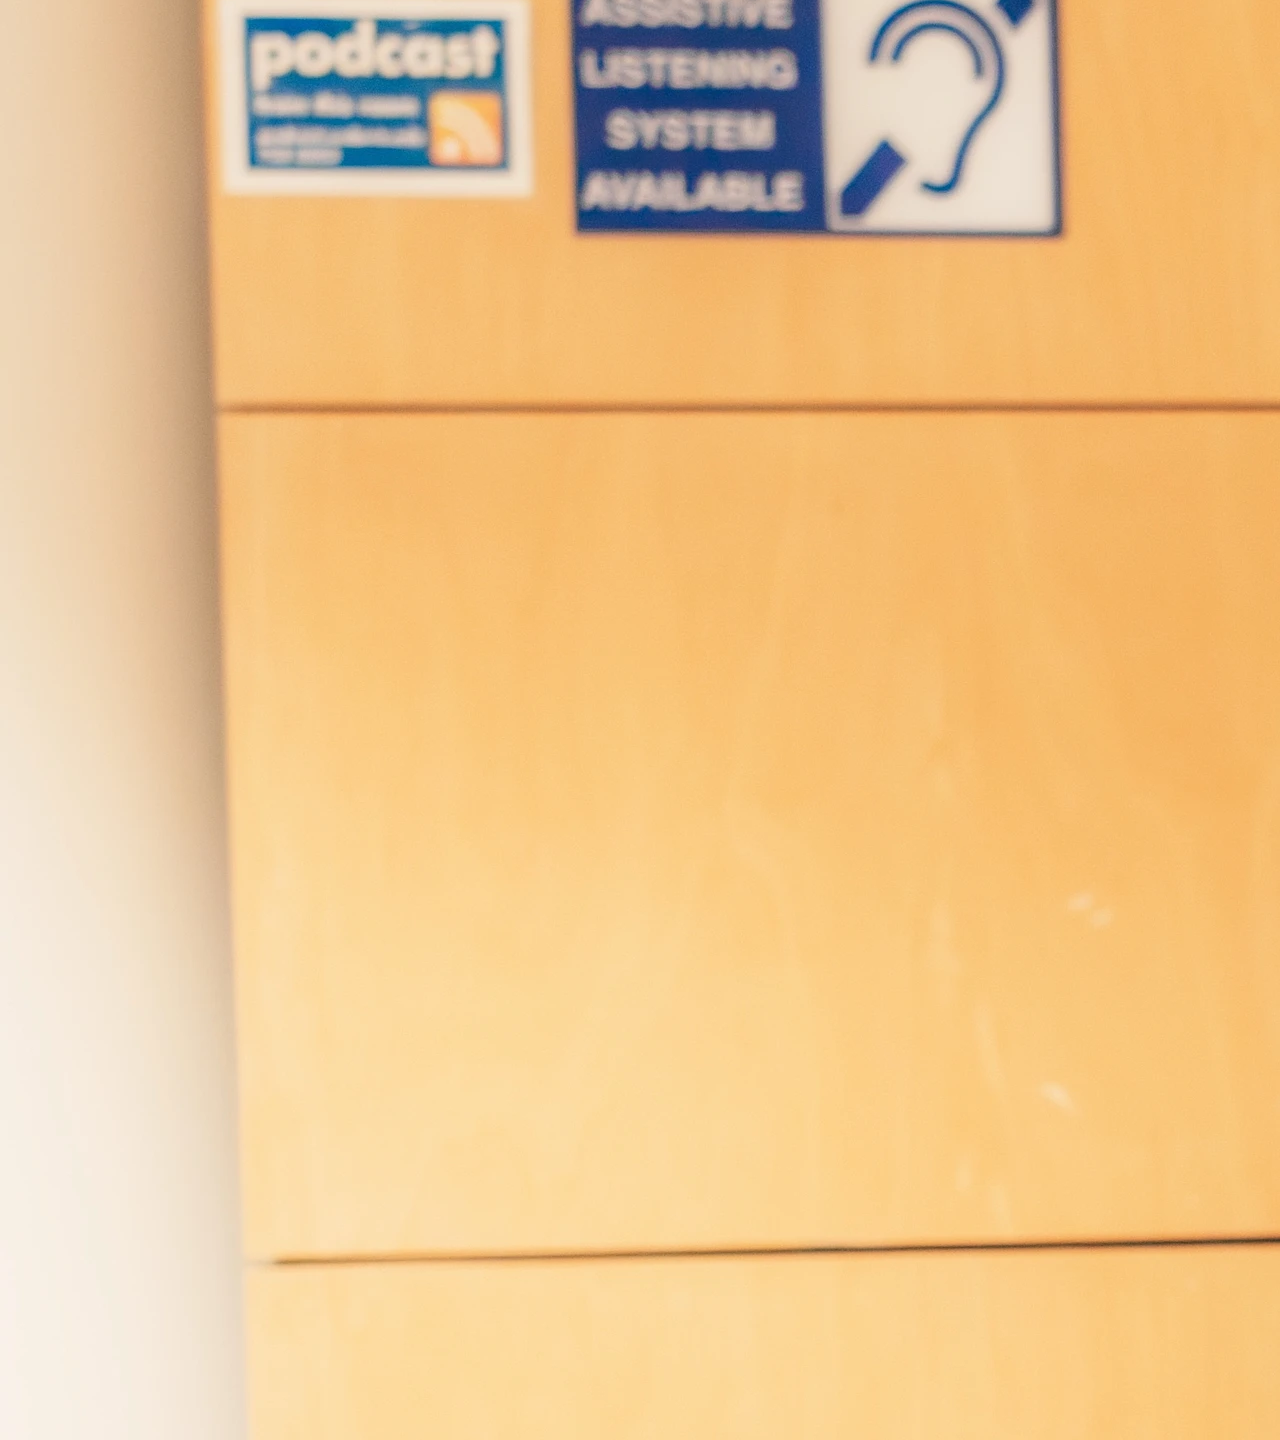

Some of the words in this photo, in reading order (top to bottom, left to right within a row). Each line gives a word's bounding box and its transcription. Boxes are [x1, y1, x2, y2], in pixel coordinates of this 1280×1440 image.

[250, 19, 498, 92] podcast
[579, 47, 799, 90] LISTENING
[605, 109, 777, 151] SYSTEM
[582, 171, 804, 212] AVAILABLE
